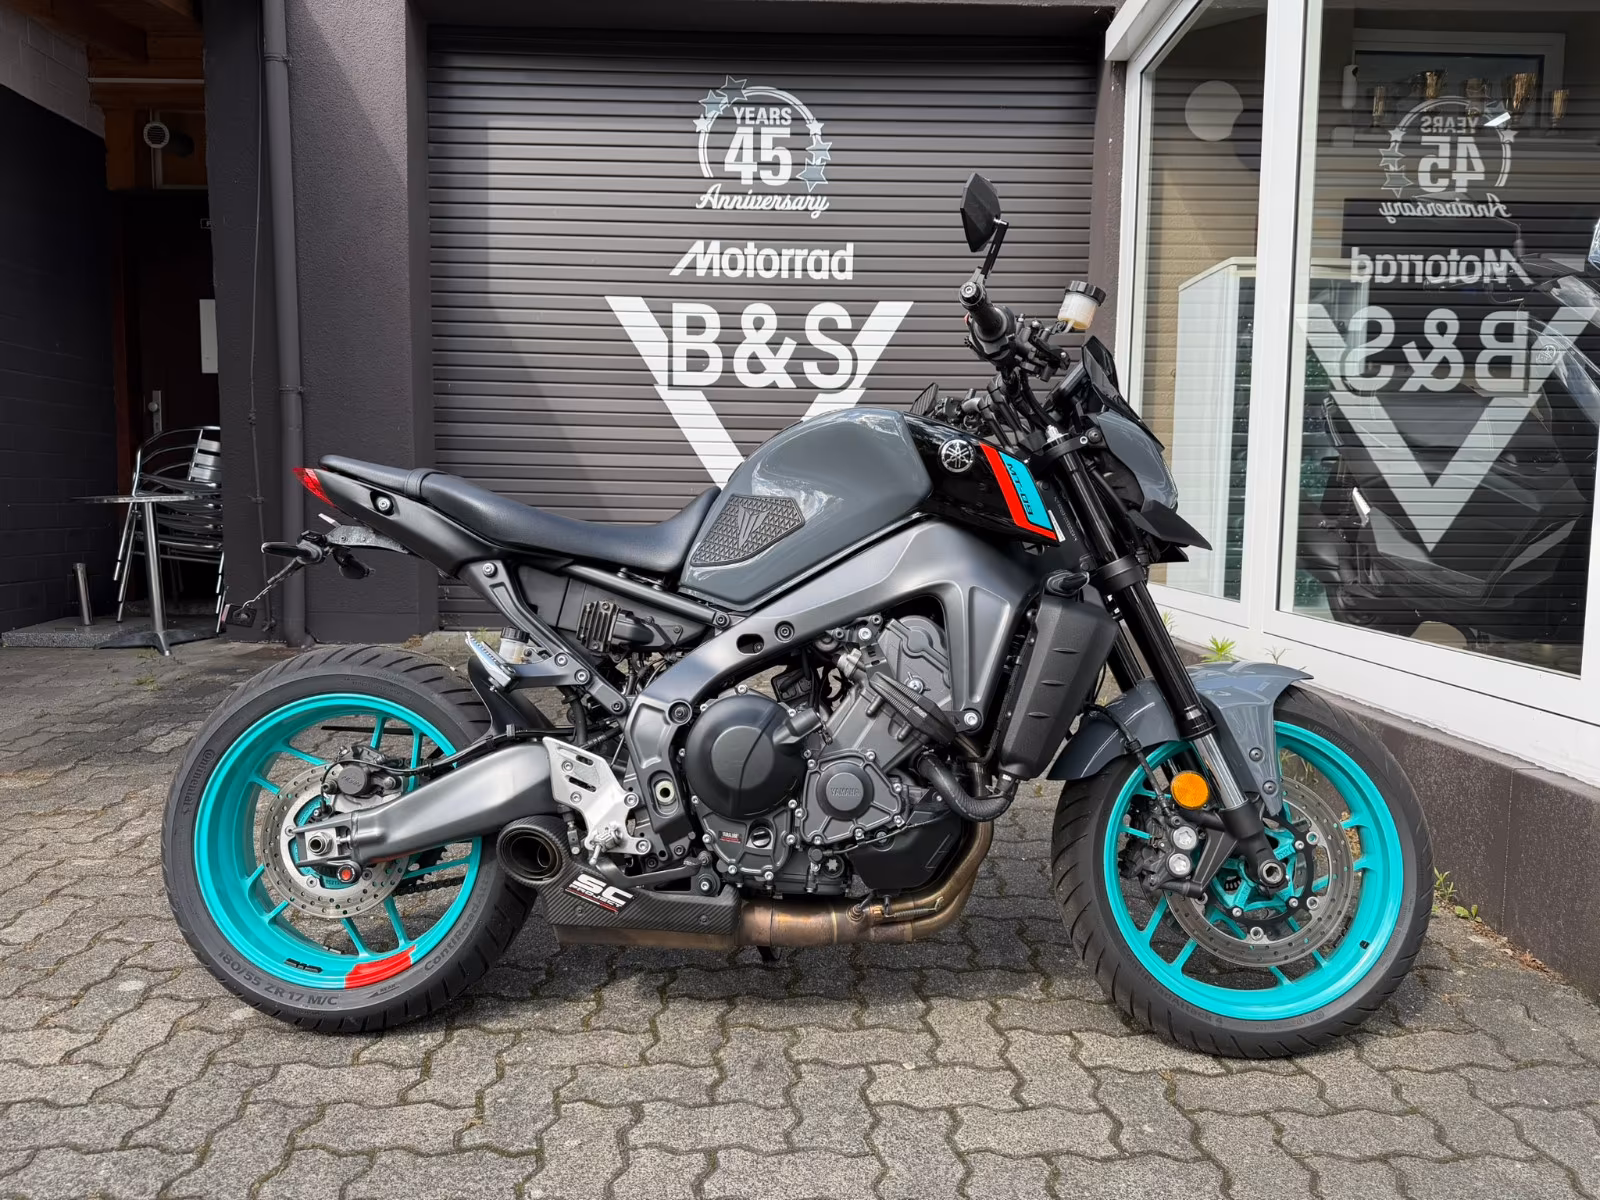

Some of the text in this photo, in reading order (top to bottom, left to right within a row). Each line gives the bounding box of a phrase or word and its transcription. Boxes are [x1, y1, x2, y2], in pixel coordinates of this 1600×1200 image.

[733, 107, 792, 125] YEARS
[724, 127, 792, 186] 45
[696, 183, 830, 219] Anniversary
[669, 240, 854, 280] Motorrad
[671, 301, 853, 389] B&S
[830, 787, 861, 797] YAMAHA
[218, 950, 339, 1006] 180/55 ZR 17 M/C
